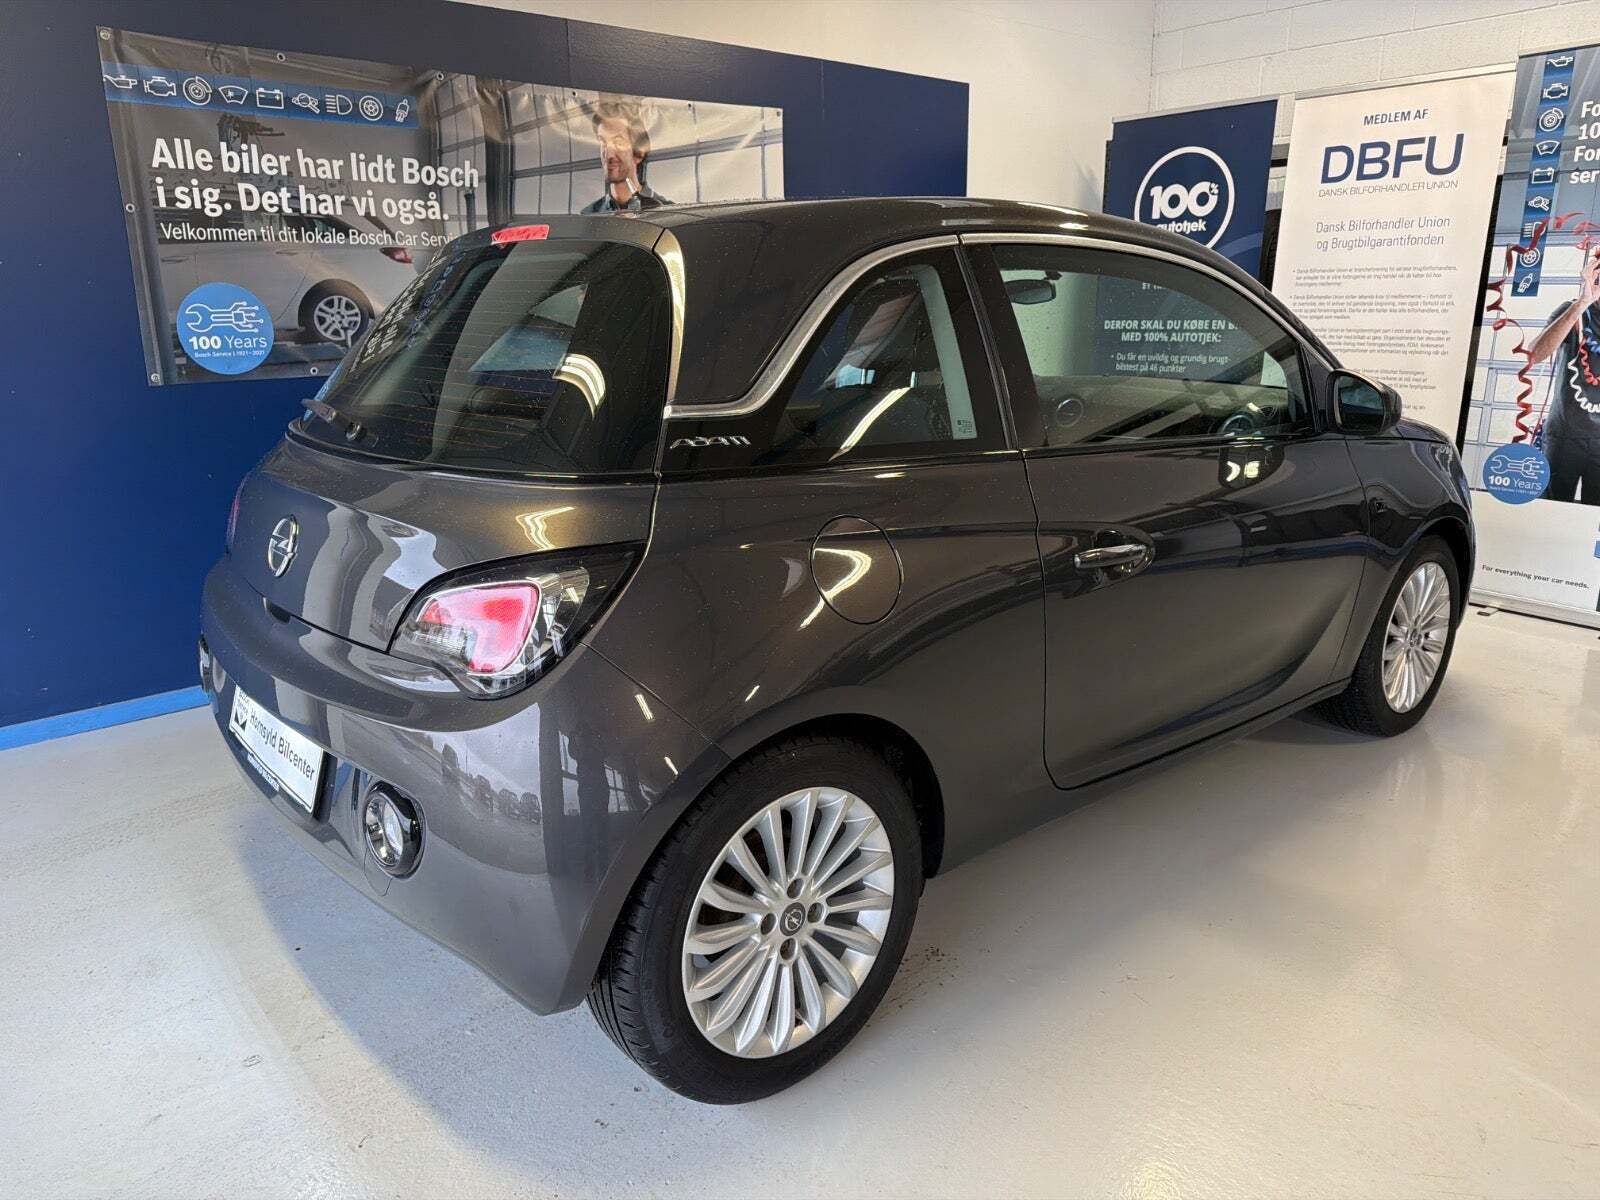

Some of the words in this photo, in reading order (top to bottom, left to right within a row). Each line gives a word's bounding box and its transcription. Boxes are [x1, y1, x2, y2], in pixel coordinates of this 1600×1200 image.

[1363, 111, 1411, 126] MEDLEM
[1413, 108, 1429, 121] AF
[151, 137, 214, 171] Alle
[219, 141, 291, 176] biler
[296, 148, 344, 180] har
[350, 152, 397, 184] lidt
[402, 157, 479, 188] Bosch
[1320, 133, 1465, 184] DBFU
[1318, 187, 1348, 198] DANSK
[1349, 181, 1425, 196] BILFORHANDLER
[1426, 179, 1459, 191] UNION
[155, 176, 167, 208] i
[174, 178, 232, 217] sig.
[237, 182, 293, 214] Det
[298, 184, 346, 216] har
[351, 189, 377, 217] vi
[382, 191, 450, 225] også.
[1315, 220, 1346, 234] Dansk
[1348, 217, 1416, 232] Bilforhandler
[1418, 215, 1451, 229] Union
[160, 222, 258, 241] Velkommen
[261, 225, 275, 242] til
[278, 225, 299, 243] dit
[301, 227, 346, 244] lokale
[349, 229, 393, 246] Bosch
[395, 230, 418, 246] Car
[421, 231, 457, 247] Servi
[1316, 241, 1329, 252] og
[1331, 235, 1445, 252] Brugtbilgarantifonden
[1103, 320, 1140, 330] DERFOR
[1140, 320, 1165, 330] SKAL
[1166, 320, 1181, 330] DU
[1183, 319, 1210, 330] KØBE
[1211, 320, 1226, 330] EN
[188, 335, 222, 350] 100
[224, 335, 268, 349] Years
[1121, 332, 1142, 342] MED
[1144, 332, 1169, 343] 100%
[1170, 332, 1222, 345] AUTOTJEK:
[1116, 353, 1126, 361] Du
[1488, 474, 1511, 486] 100
[1512, 475, 1542, 491] Years
[1481, 564, 1493, 572] For
[1494, 566, 1532, 580] everything
[1533, 573, 1549, 583] your
[278, 736, 315, 781] Bilcenter
